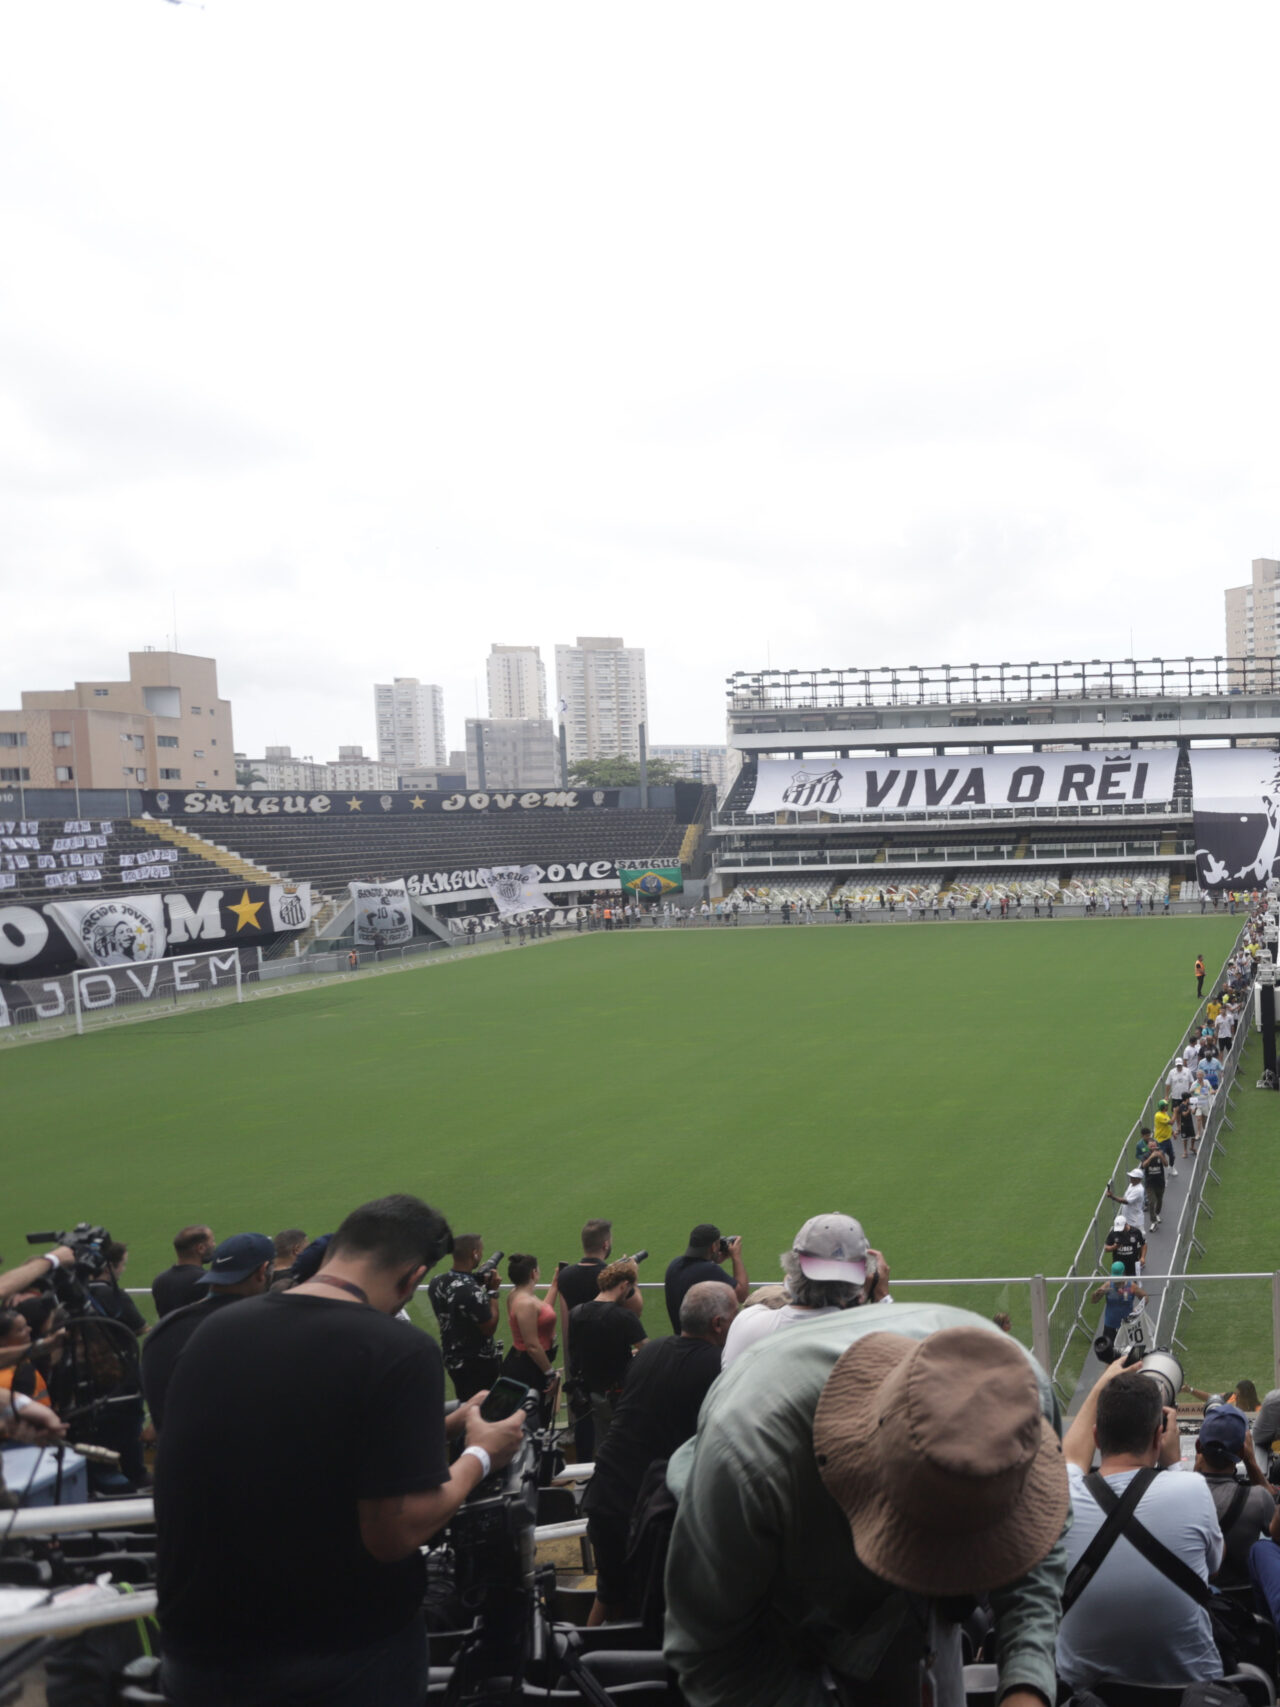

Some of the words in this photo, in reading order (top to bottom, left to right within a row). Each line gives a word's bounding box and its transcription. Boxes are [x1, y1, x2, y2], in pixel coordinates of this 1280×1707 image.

[866, 768, 986, 808] VIVA
[1008, 766, 1045, 803] O
[82, 904, 118, 942] TORCIDA
[121, 904, 154, 933] JOVEM
[36, 952, 239, 1018] JOVEM
